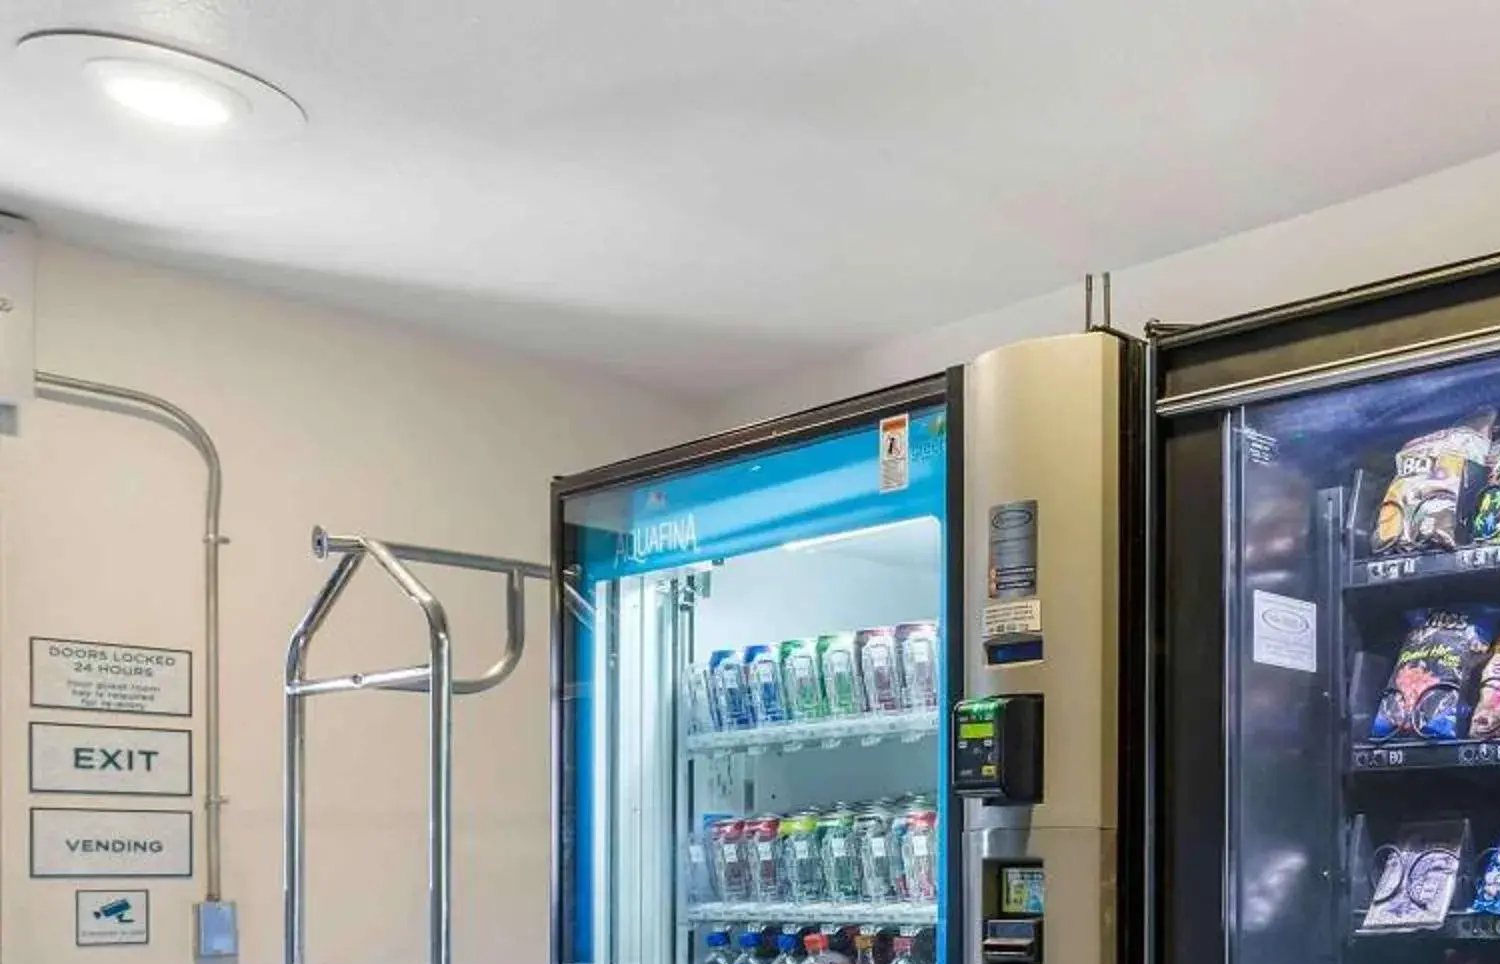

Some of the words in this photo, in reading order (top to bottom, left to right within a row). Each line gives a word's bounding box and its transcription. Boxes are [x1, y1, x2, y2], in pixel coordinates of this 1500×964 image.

[49, 646, 108, 660] DOORS
[113, 651, 176, 667] LOCKED
[73, 660, 93, 673] 24
[98, 664, 154, 677] HOURS
[73, 747, 160, 772] EXIT
[66, 838, 164, 854] VENDING
